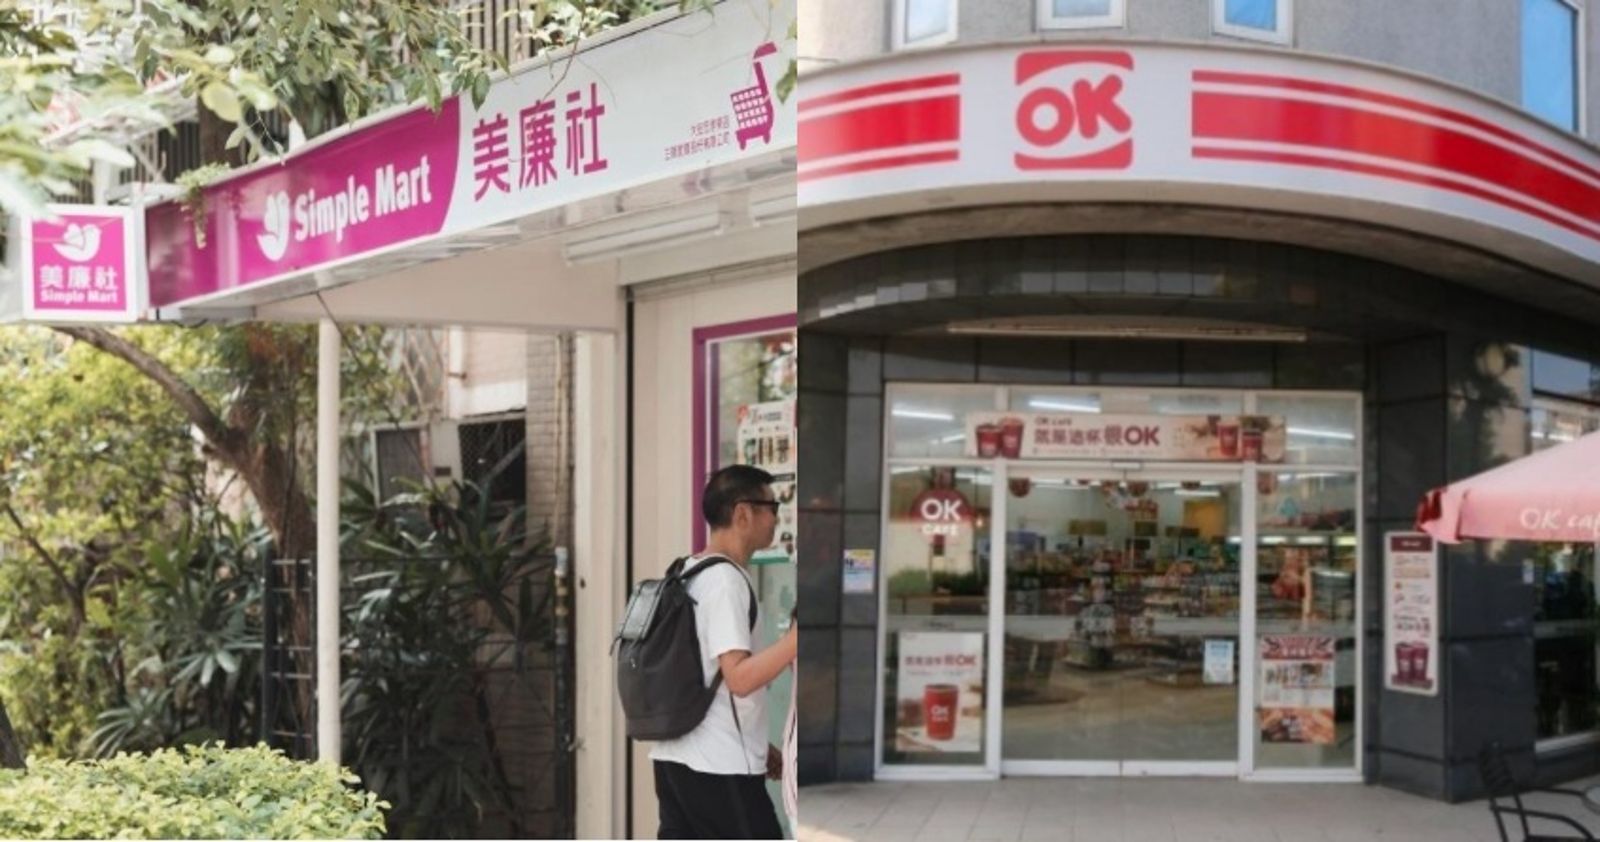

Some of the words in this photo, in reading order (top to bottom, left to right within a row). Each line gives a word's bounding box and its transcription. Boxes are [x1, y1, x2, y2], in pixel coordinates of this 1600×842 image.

[1016, 74, 1132, 147] OK
[473, 82, 608, 201] 美廉社
[294, 176, 370, 242] Simple
[375, 156, 432, 217] Mart
[40, 265, 118, 289] 美廉社
[40, 289, 85, 304] Simple
[87, 289, 118, 303] Mart
[921, 498, 961, 521] OK
[1520, 508, 1562, 530] OK
